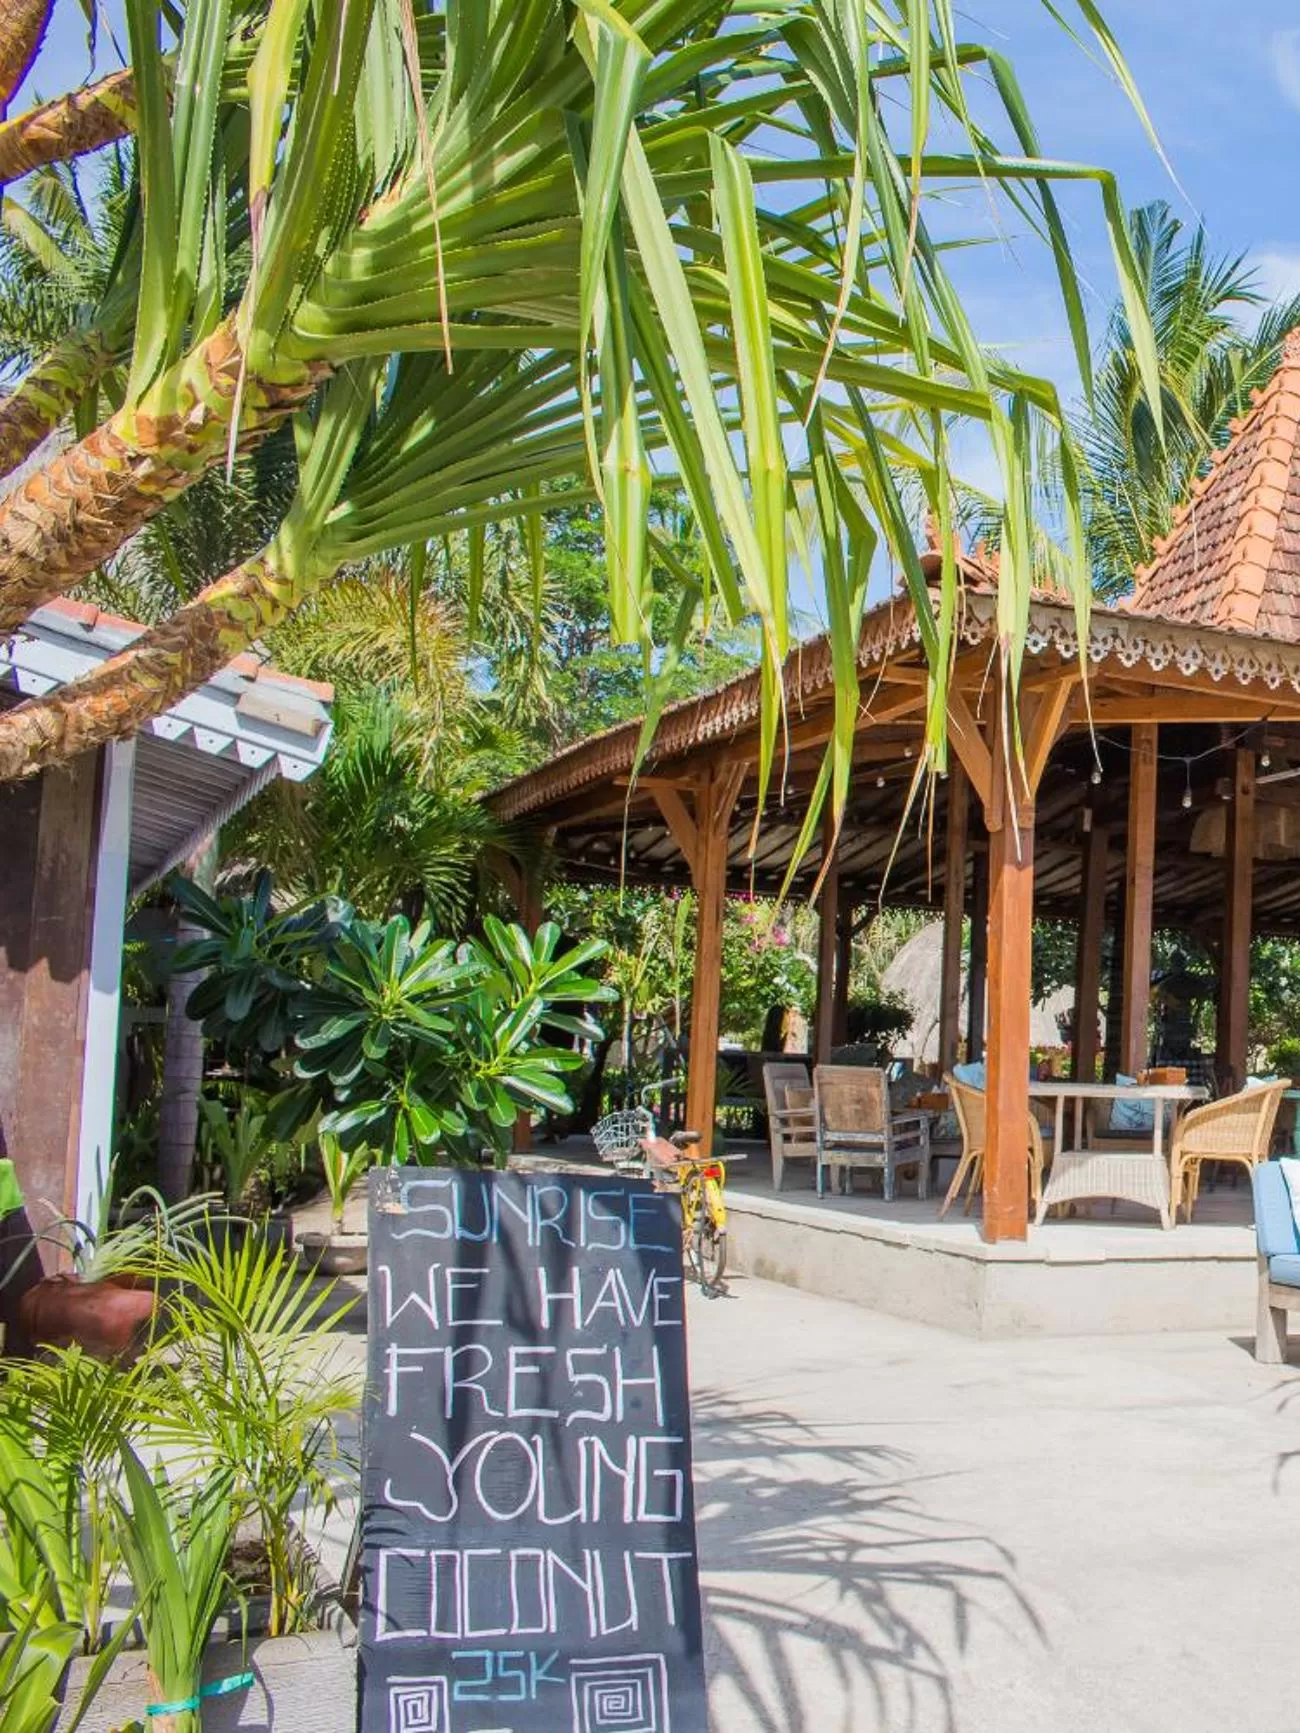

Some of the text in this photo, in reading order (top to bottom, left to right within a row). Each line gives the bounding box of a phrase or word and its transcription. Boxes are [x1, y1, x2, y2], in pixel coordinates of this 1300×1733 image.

[391, 1177, 674, 1253] SUNRISE
[378, 1263, 682, 1331] WE HAVE
[384, 1343, 664, 1427] FRESH
[384, 1427, 684, 1525] YOUNG
[375, 1548, 693, 1641] COCONUT
[451, 1649, 566, 1701] 25K
